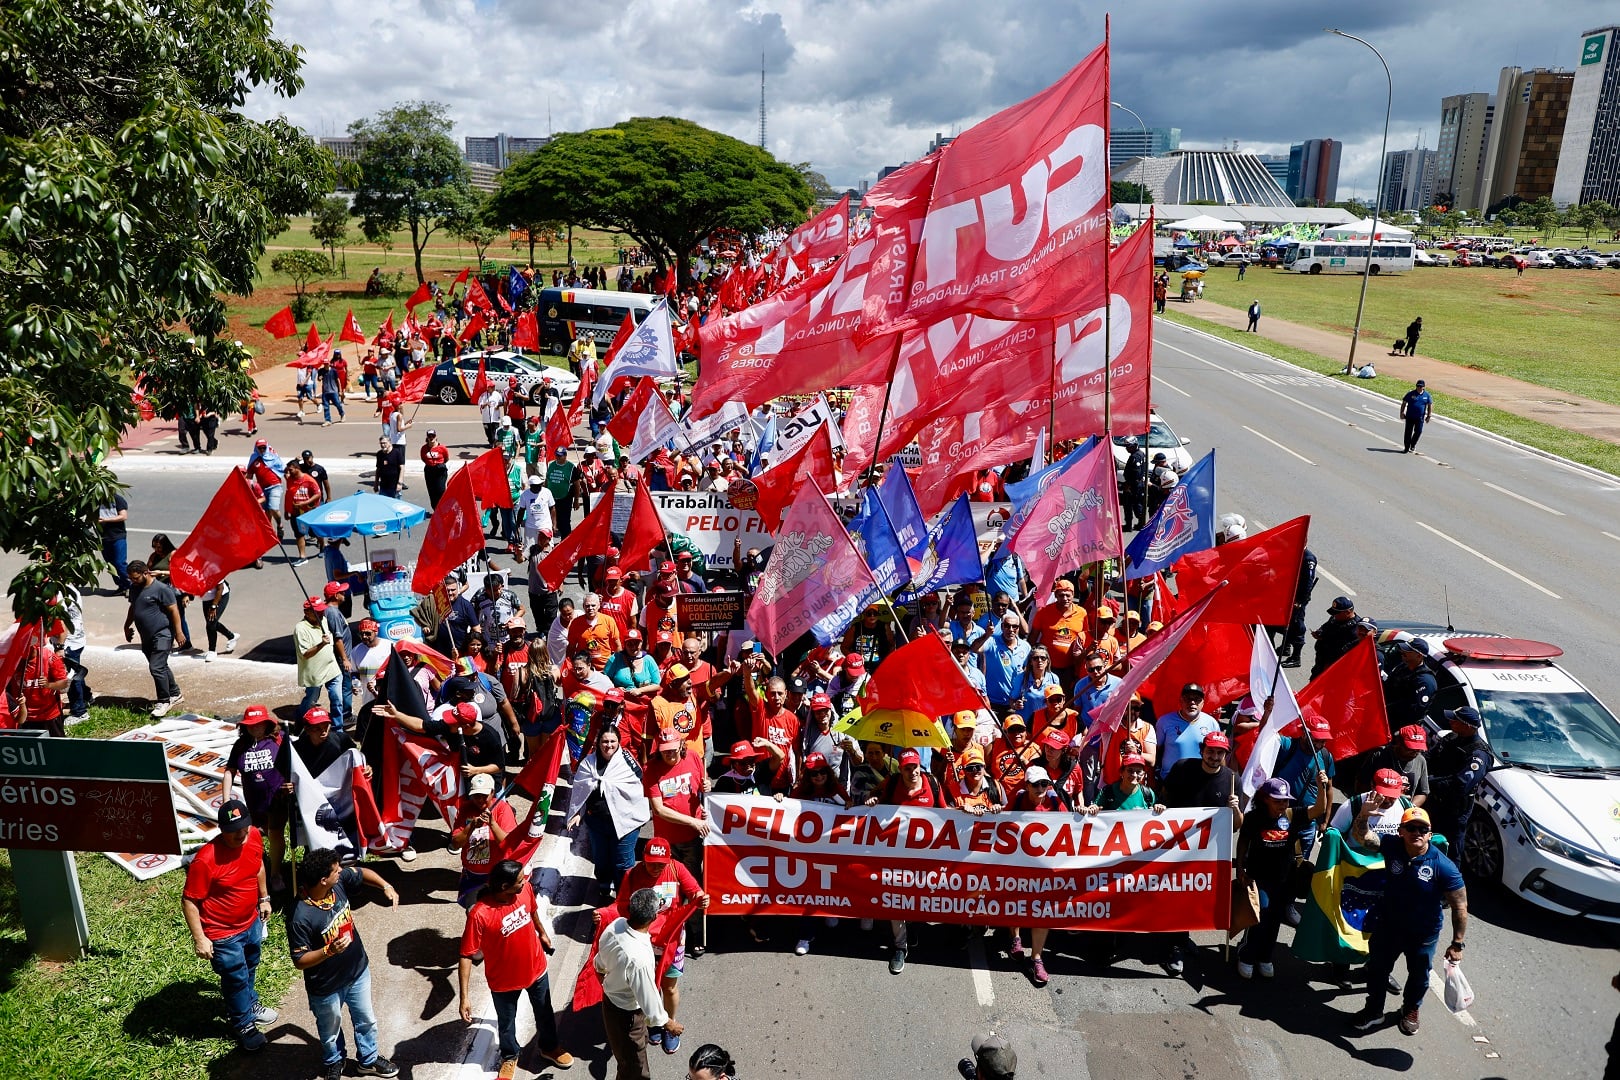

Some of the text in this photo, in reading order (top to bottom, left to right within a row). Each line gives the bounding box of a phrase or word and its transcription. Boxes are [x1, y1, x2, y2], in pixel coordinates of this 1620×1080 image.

[659, 494, 735, 510] Trabalha
[685, 515, 740, 532] PELO
[682, 602, 740, 613] NEGOCIAÇÕES
[688, 612, 734, 621] COLETIVAS
[2, 741, 47, 766] sul
[0, 778, 77, 806] érios
[721, 804, 1214, 857] PELO FIM DA ESCALA 6X1
[734, 856, 838, 890] CUT
[881, 866, 1213, 893] REDUÇÃO DA JORNADA DE TRABALHO!
[721, 893, 852, 907] SANTA CATARINA
[881, 891, 1111, 919] SEM REDUÇÃO DE SALÁRIO!
